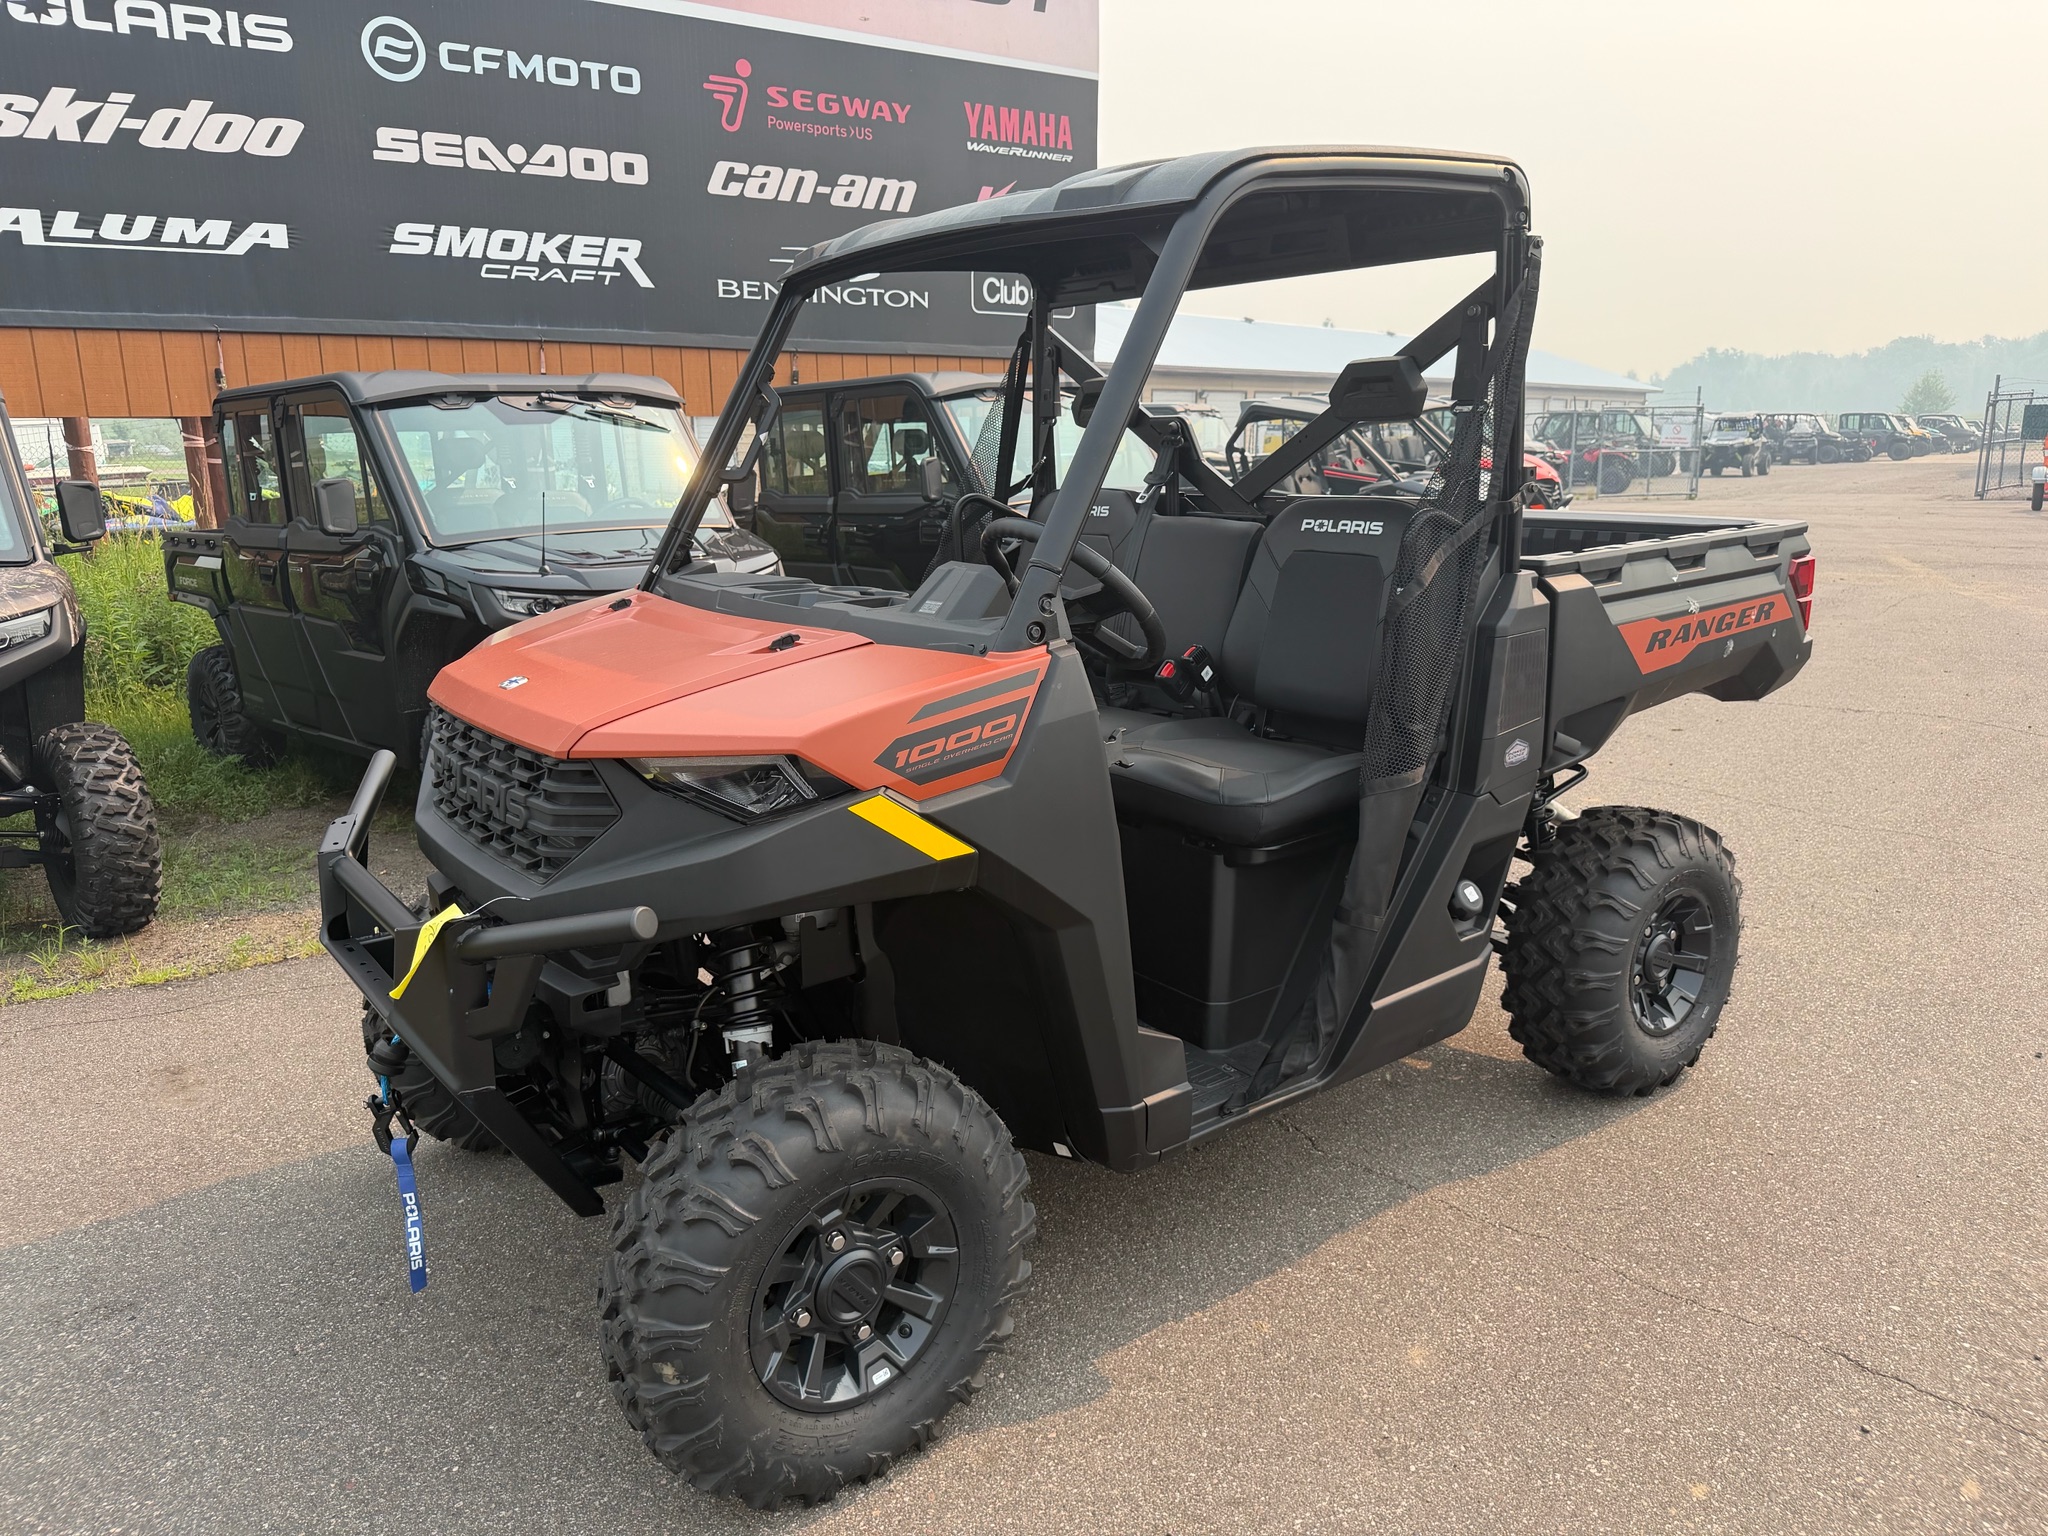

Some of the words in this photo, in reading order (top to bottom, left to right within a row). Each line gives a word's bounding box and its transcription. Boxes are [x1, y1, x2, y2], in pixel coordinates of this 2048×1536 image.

[4, 0, 293, 52] OLARIS
[438, 42, 641, 95] CFMOTO
[0, 87, 305, 157] ski-doo
[766, 86, 911, 124] SEGWAY
[963, 101, 1073, 150] YAMAHA
[707, 160, 917, 213] can-am
[0, 207, 289, 255] ALUMA
[389, 221, 655, 288] SMOKER
[480, 264, 621, 286] CRAFT
[717, 279, 929, 309] BENINGTON
[982, 277, 1027, 305] Club
[1301, 518, 1384, 535] POLARIS
[1645, 601, 1776, 654] RANGER
[895, 714, 1017, 769] 1000
[905, 758, 940, 773] SINGLE
[943, 741, 992, 761] OVERHEAD
[993, 733, 1013, 745] CAM
[430, 740, 530, 830] POLARIS
[402, 1192, 423, 1270] POLARIS
